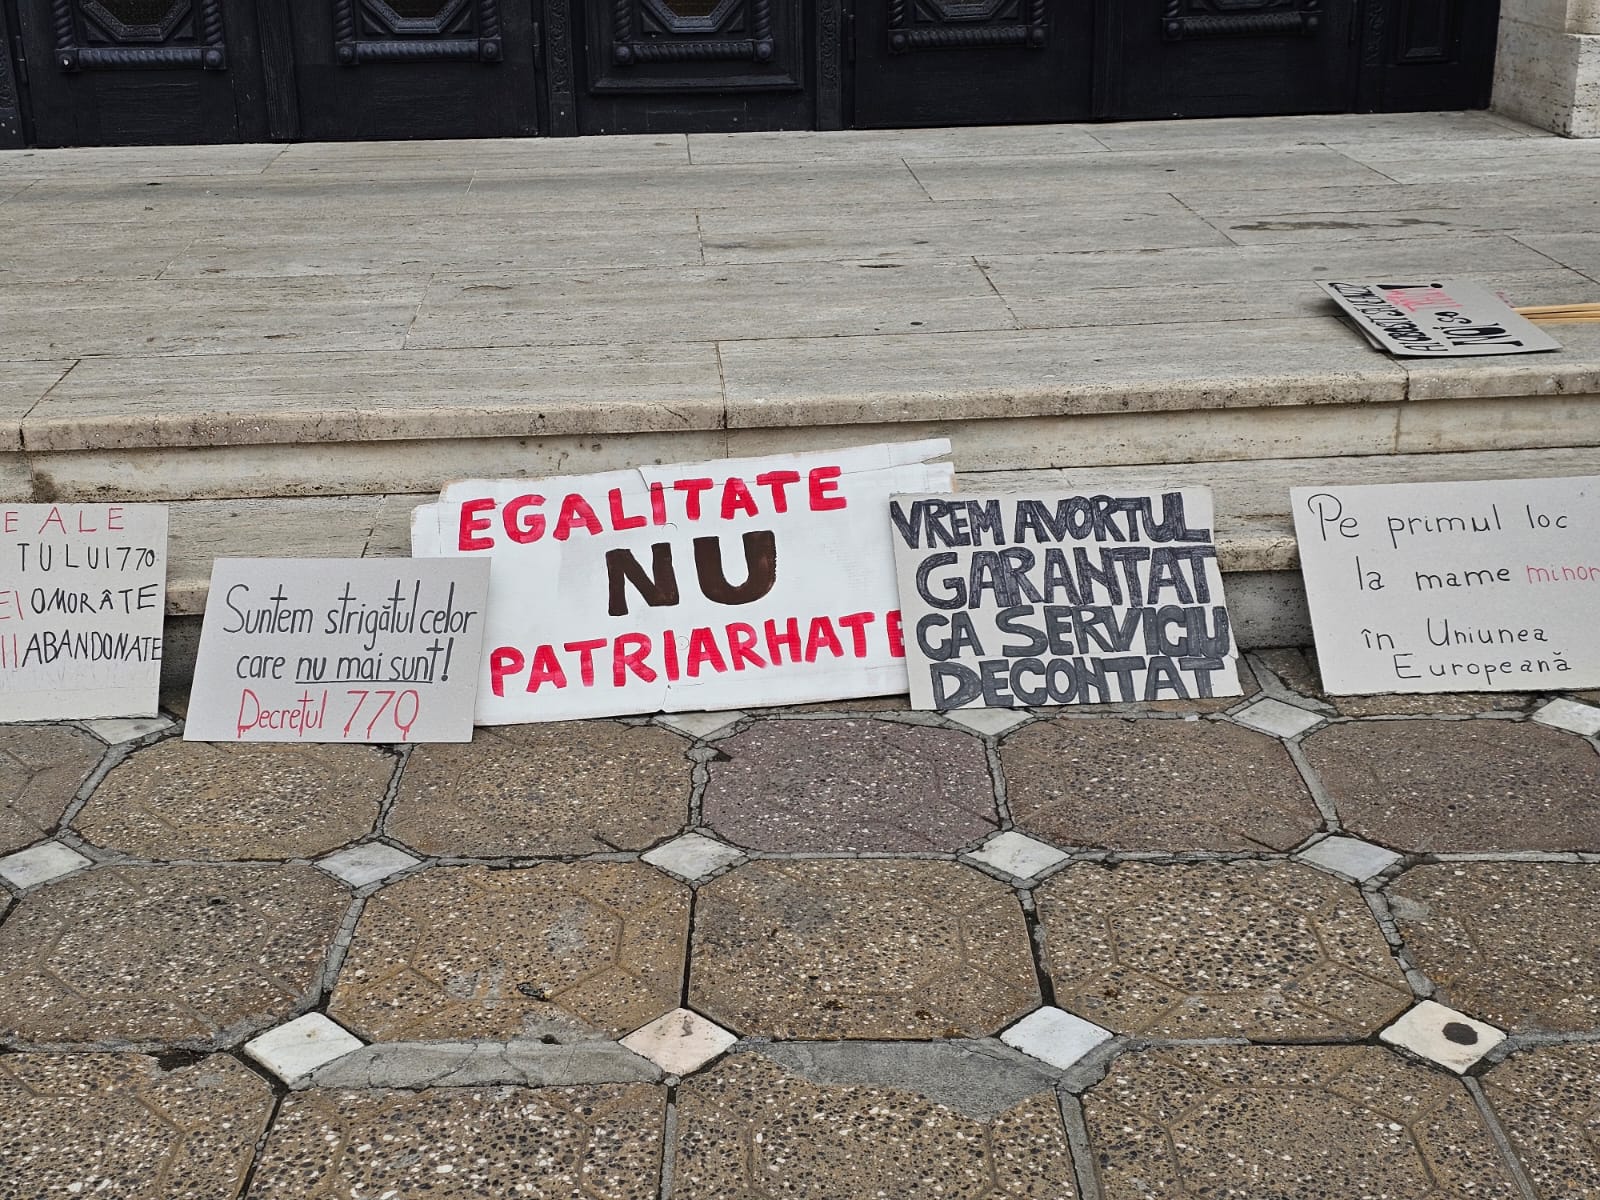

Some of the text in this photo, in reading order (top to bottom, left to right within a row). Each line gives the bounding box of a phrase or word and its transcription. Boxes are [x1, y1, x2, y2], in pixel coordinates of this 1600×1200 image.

[458, 466, 847, 551] EGALITATE
[890, 492, 1211, 549] VREM AVORTUL
[1307, 493, 1568, 549] Pe primul loc
[30, 584, 159, 615] OMORÂTE
[605, 530, 777, 616] NU
[915, 545, 1217, 610] GARANTAT
[1355, 555, 1384, 590] la
[1415, 566, 1511, 591] mame
[223, 579, 478, 651] Suntem strigătul celor
[915, 604, 1230, 661] CA SERVICIU
[1360, 617, 1549, 650] în Uniunea
[22, 629, 162, 668] ABANDONATE
[236, 637, 455, 682] care nu mai sunt!
[1393, 651, 1572, 685] Europeană
[929, 656, 1225, 709] DECONTAT
[236, 688, 420, 742] Decretul 770
